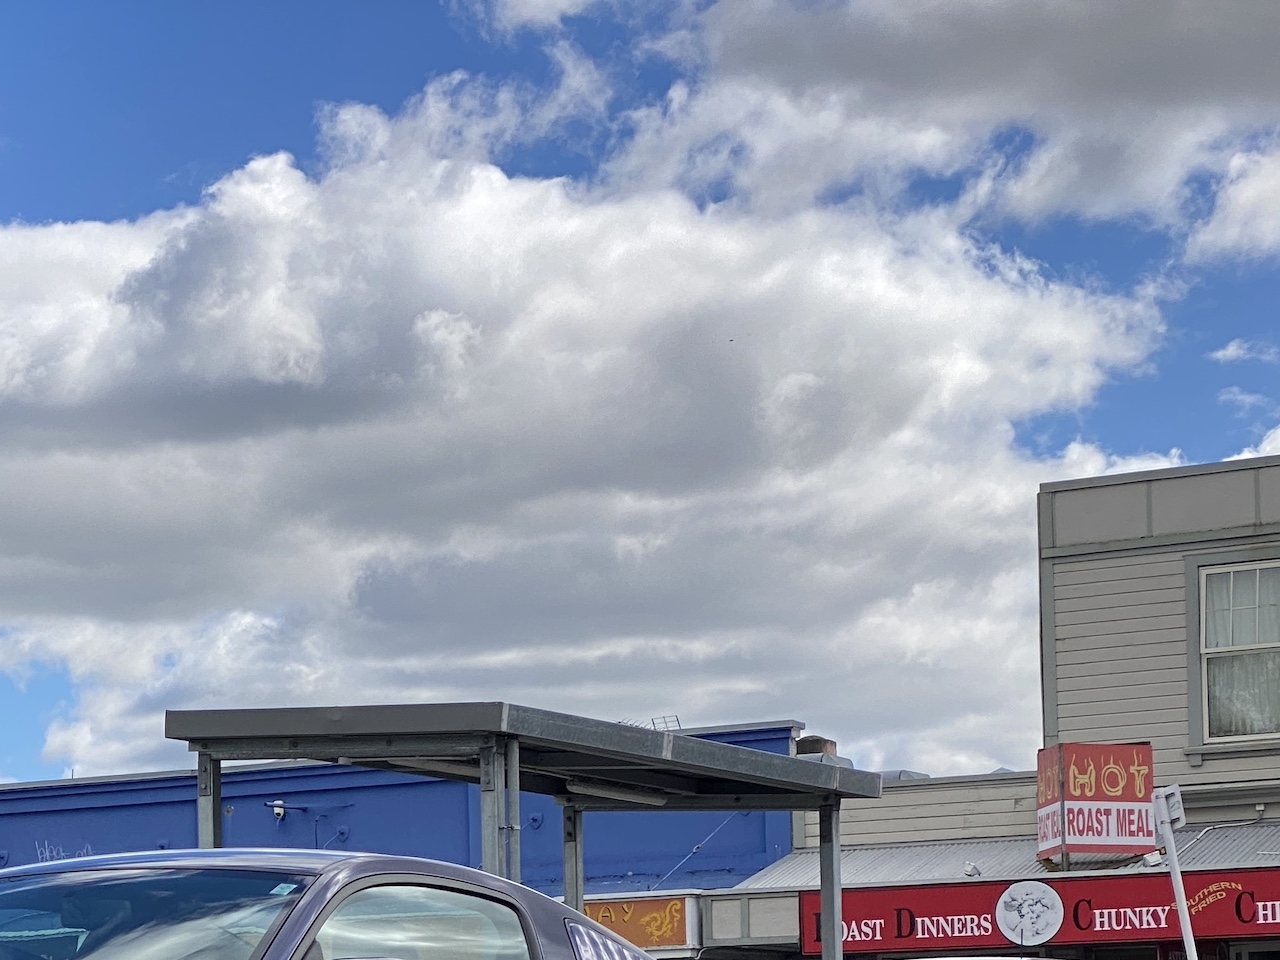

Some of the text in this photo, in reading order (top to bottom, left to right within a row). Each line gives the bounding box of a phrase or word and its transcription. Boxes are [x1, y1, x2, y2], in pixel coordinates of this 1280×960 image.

[1069, 758, 1149, 798] HOT
[1066, 807, 1154, 838] ROAST MEAL
[1073, 899, 1170, 931] CHUNKY
[1191, 891, 1227, 915] FRIED
[894, 908, 992, 939] DINNERS
